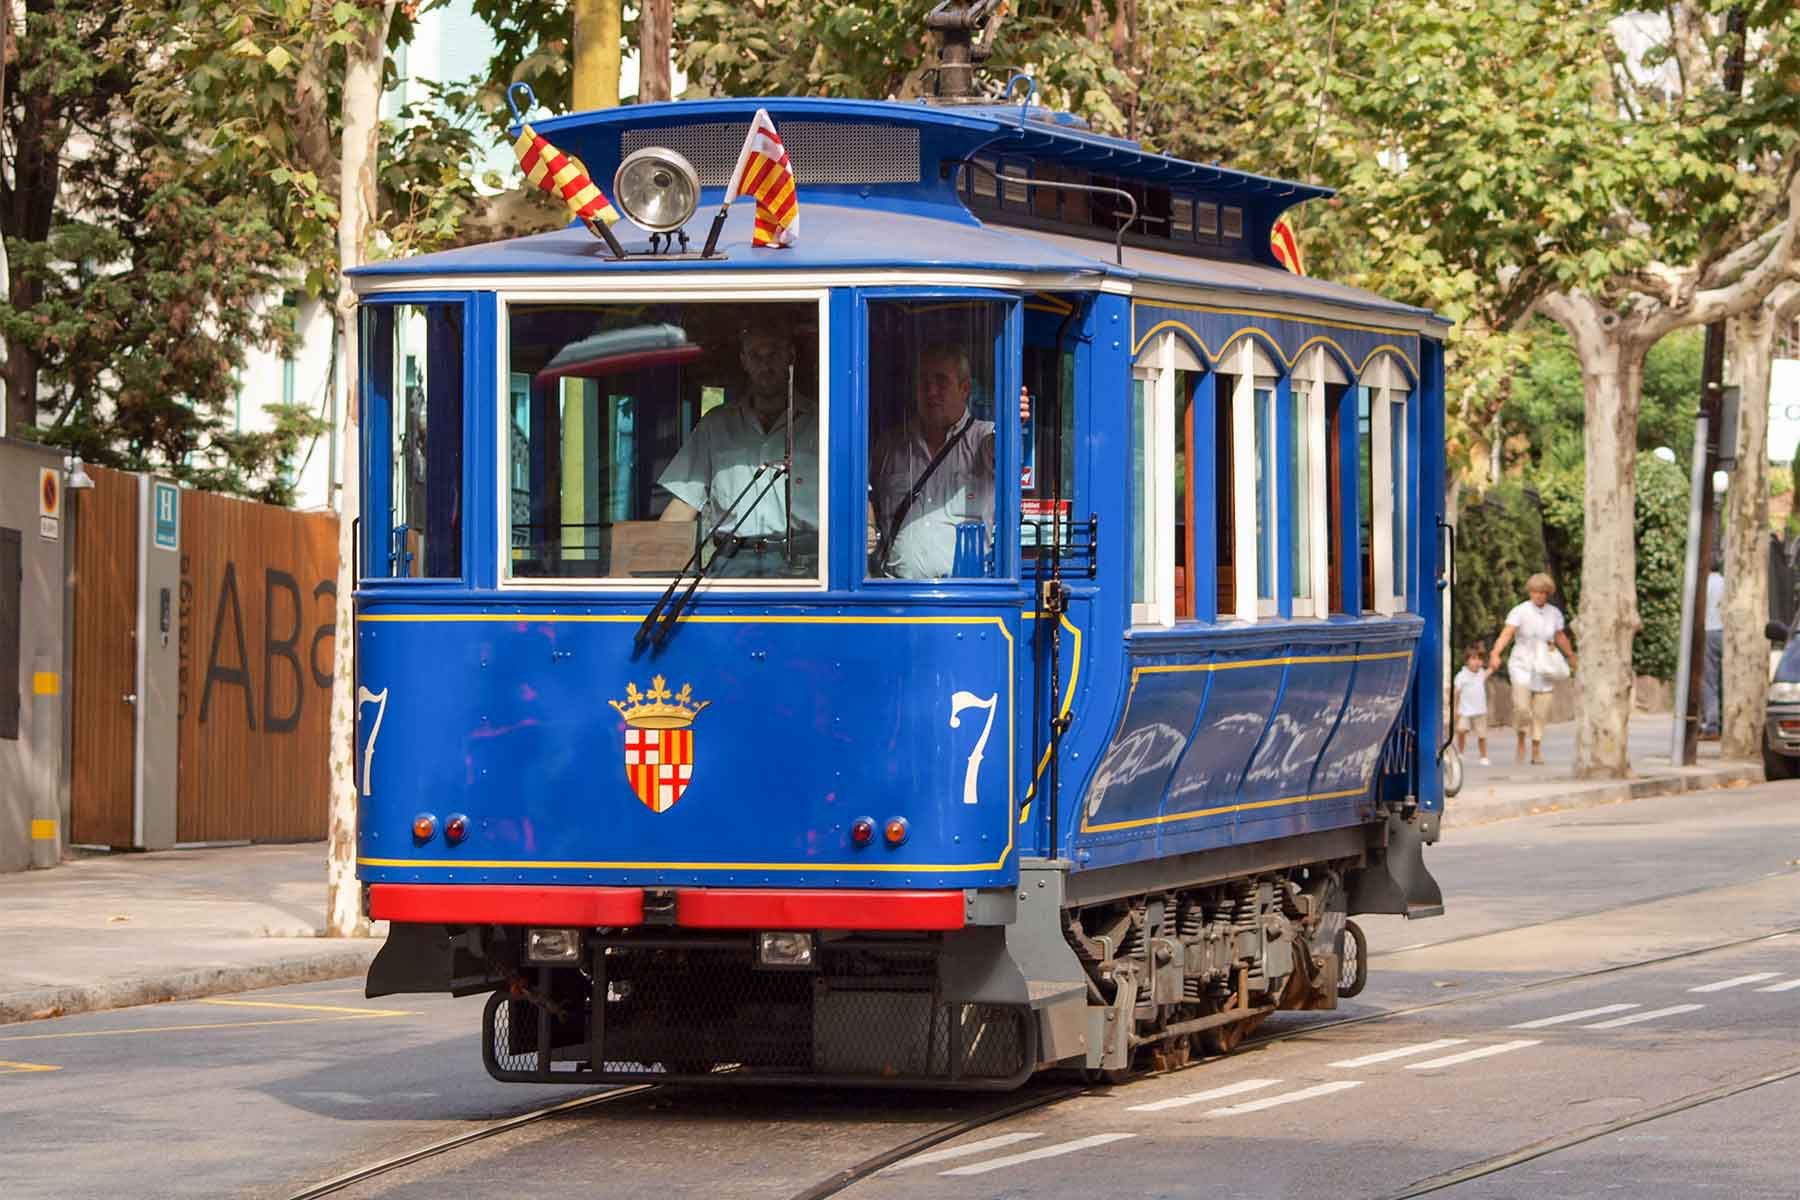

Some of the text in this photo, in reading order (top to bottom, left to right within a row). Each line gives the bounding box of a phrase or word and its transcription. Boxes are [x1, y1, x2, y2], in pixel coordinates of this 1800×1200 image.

[160, 489, 173, 520] H
[359, 685, 388, 796] 7
[949, 690, 998, 804] 7
